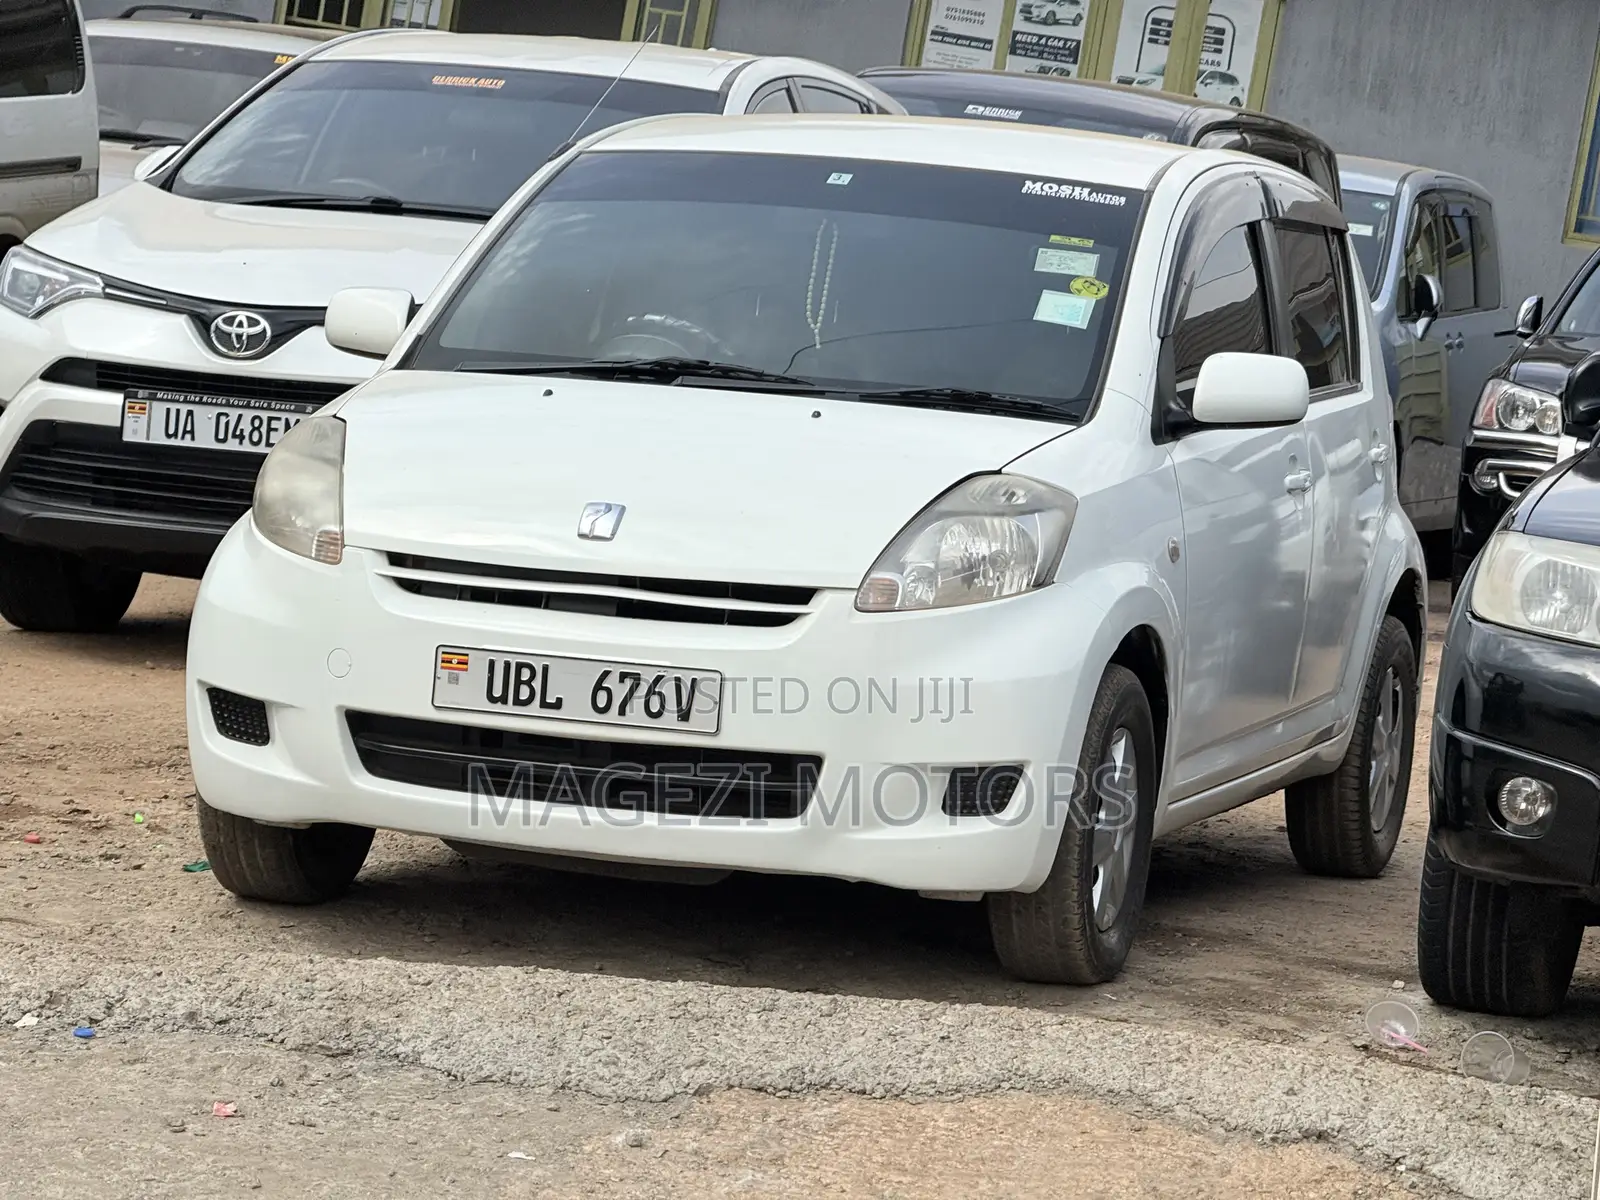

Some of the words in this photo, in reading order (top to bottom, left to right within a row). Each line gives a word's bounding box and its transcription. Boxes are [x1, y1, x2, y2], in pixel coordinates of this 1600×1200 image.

[1014, 33, 1039, 43] NEED
[1039, 36, 1047, 45] A
[1047, 37, 1065, 48] CAR
[1023, 180, 1091, 198] MOSH
[1089, 191, 1127, 203] AUTOS
[156, 391, 185, 402] Making
[186, 394, 200, 402] the
[202, 395, 227, 405] Roads
[229, 398, 248, 406] Your
[250, 400, 268, 408] Safe
[270, 401, 296, 411] Space
[164, 407, 196, 442] UA
[485, 657, 563, 711] UBL
[590, 668, 698, 722] 676V
